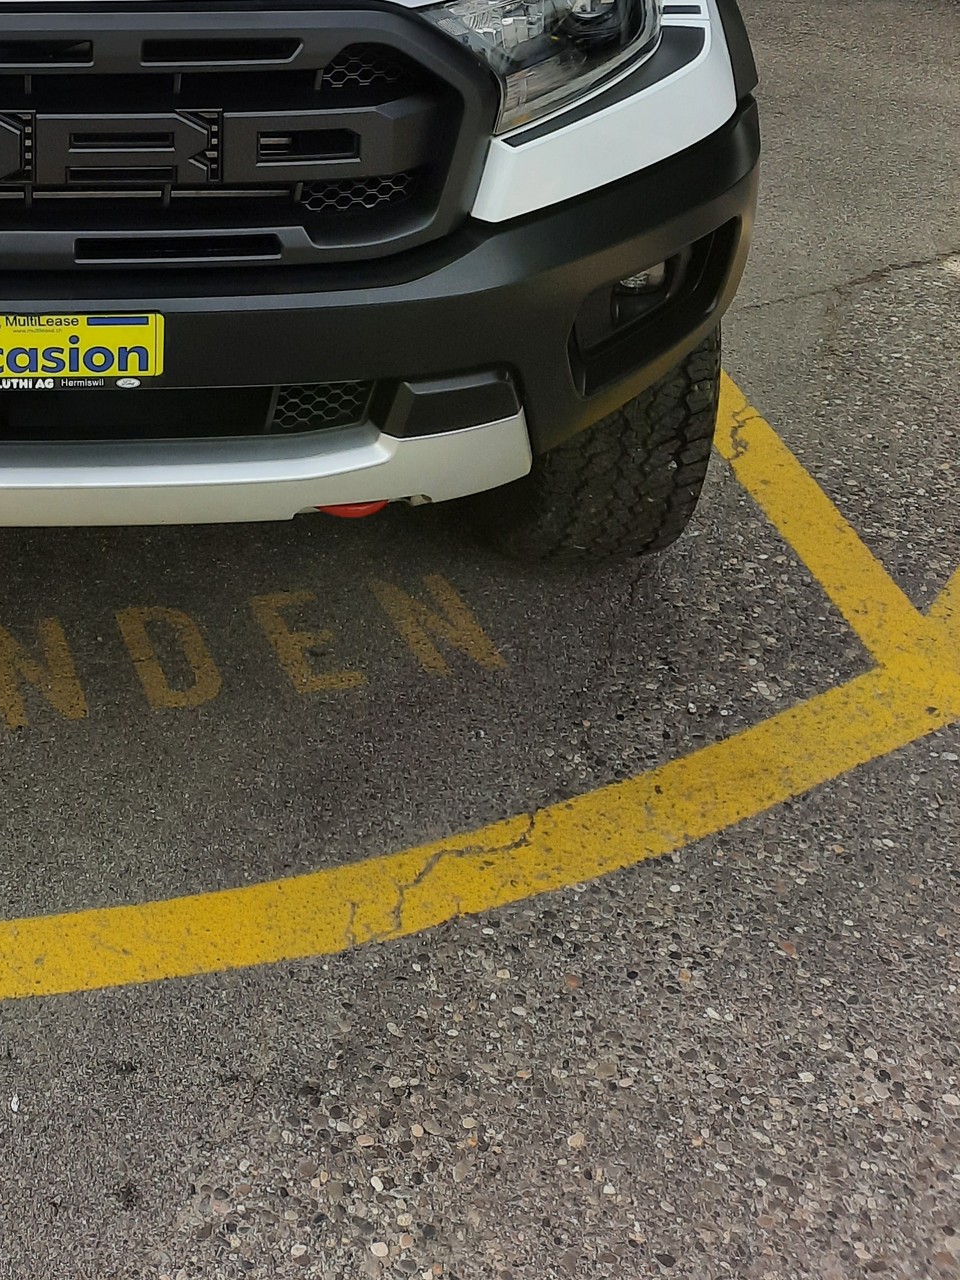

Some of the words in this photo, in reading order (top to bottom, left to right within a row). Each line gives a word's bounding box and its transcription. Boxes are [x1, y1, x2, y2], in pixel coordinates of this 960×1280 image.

[5, 315, 79, 327] MultiLease
[35, 378, 54, 389] AG
[61, 378, 104, 387] Hermiswil
